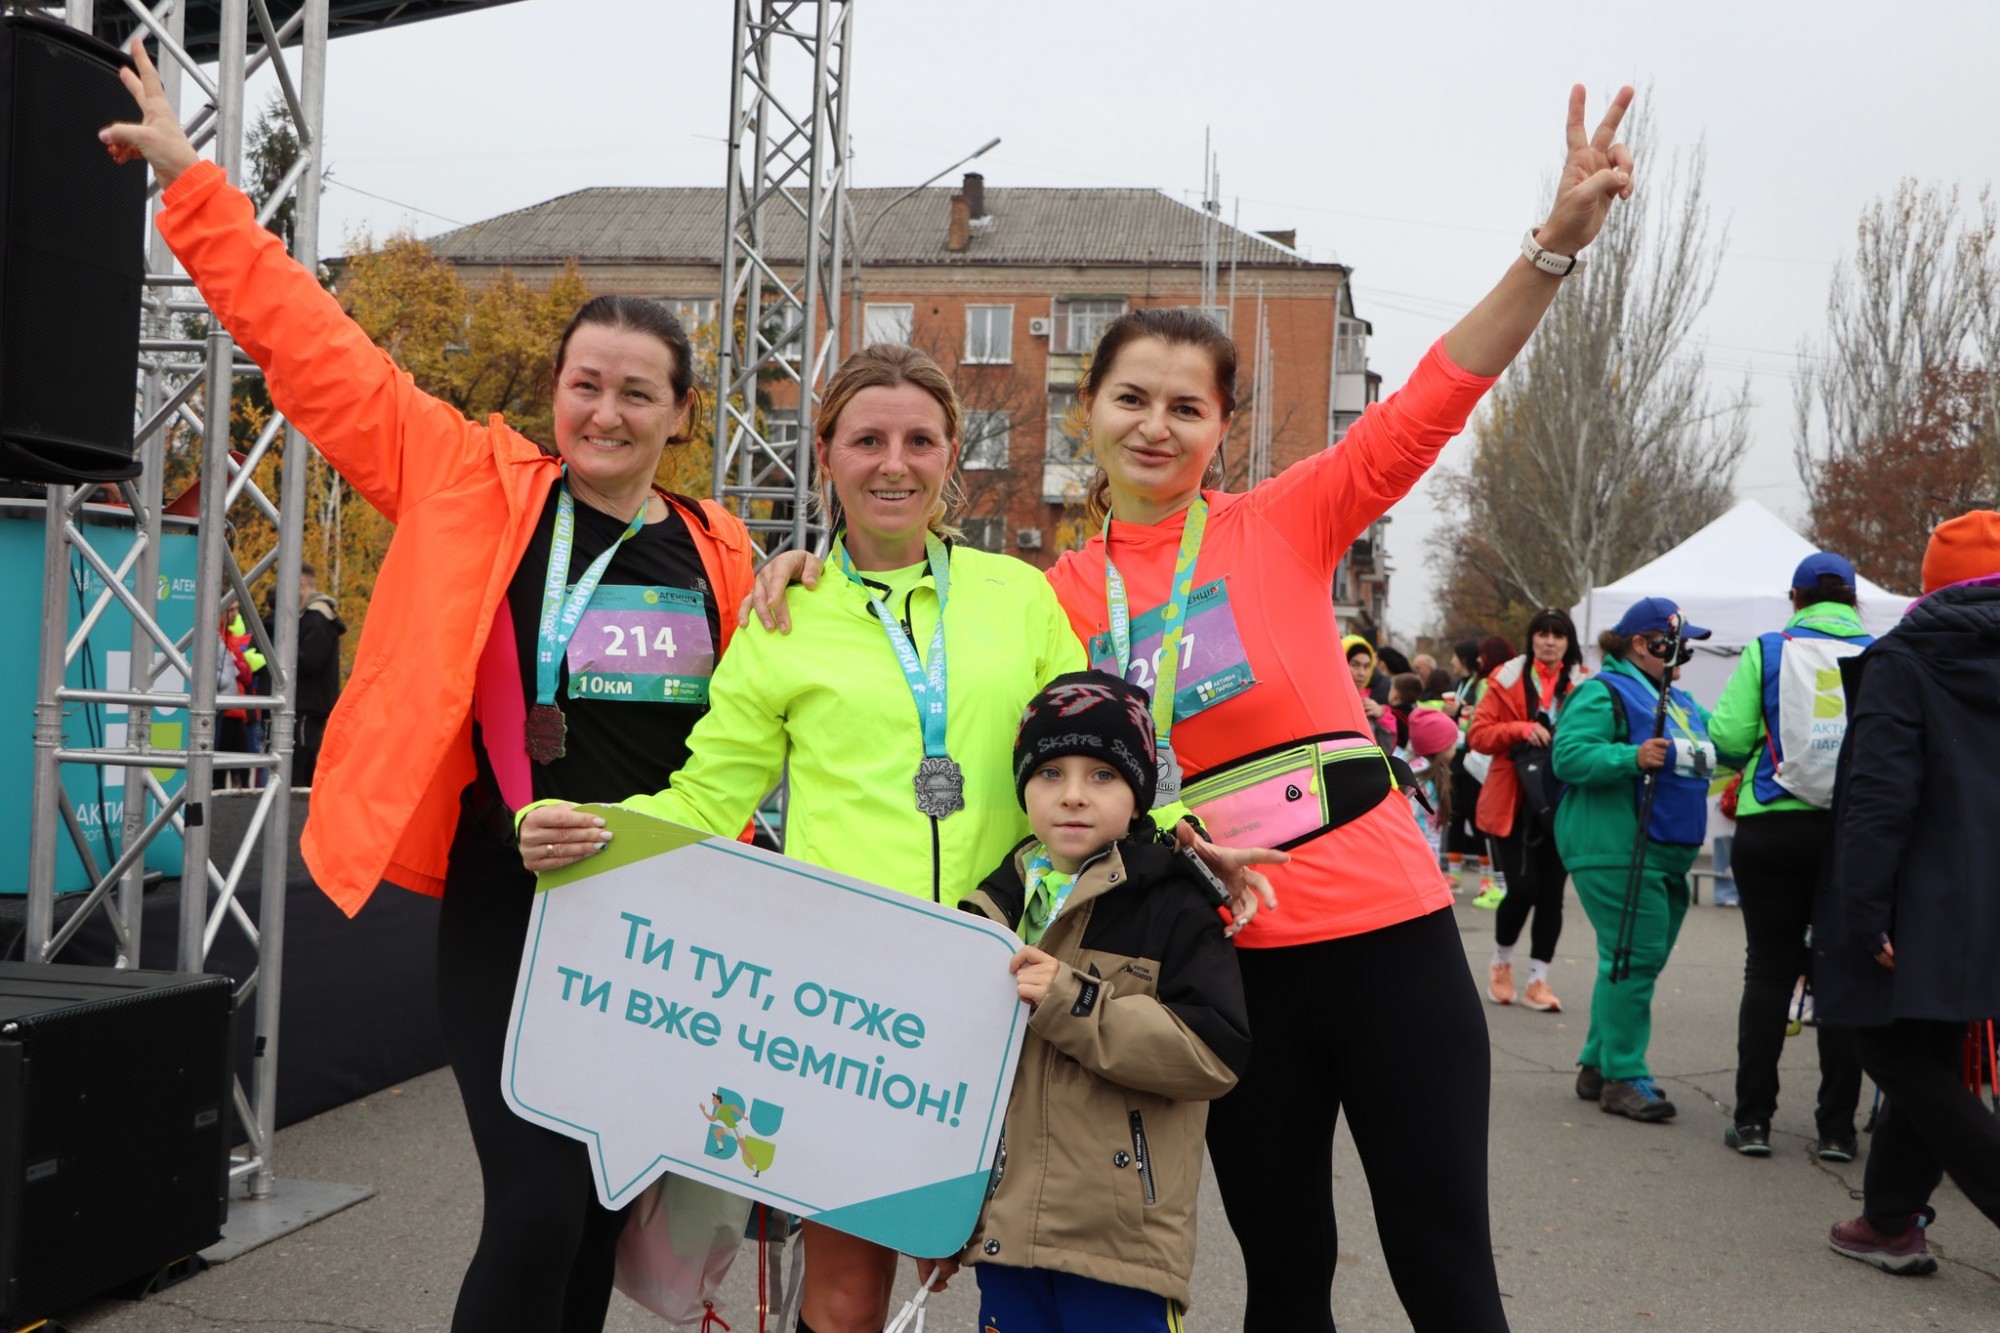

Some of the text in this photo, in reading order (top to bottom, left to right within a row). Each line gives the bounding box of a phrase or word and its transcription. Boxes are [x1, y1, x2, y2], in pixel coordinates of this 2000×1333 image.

[548, 491, 573, 600] АКТИВНІ ПАРКИ
[172, 578, 196, 592] АГЕН
[562, 577, 595, 625] ПАРКИ
[602, 624, 678, 658] 214
[886, 626, 920, 674] ПАРКИ
[1111, 603, 1128, 664] АКТИВНІ
[1810, 738, 1840, 751] ПАР
[76, 800, 124, 826] АКТИ
[620, 911, 926, 1049] Ти тут, отже
[557, 965, 968, 1128] ти вже чемпіон!
